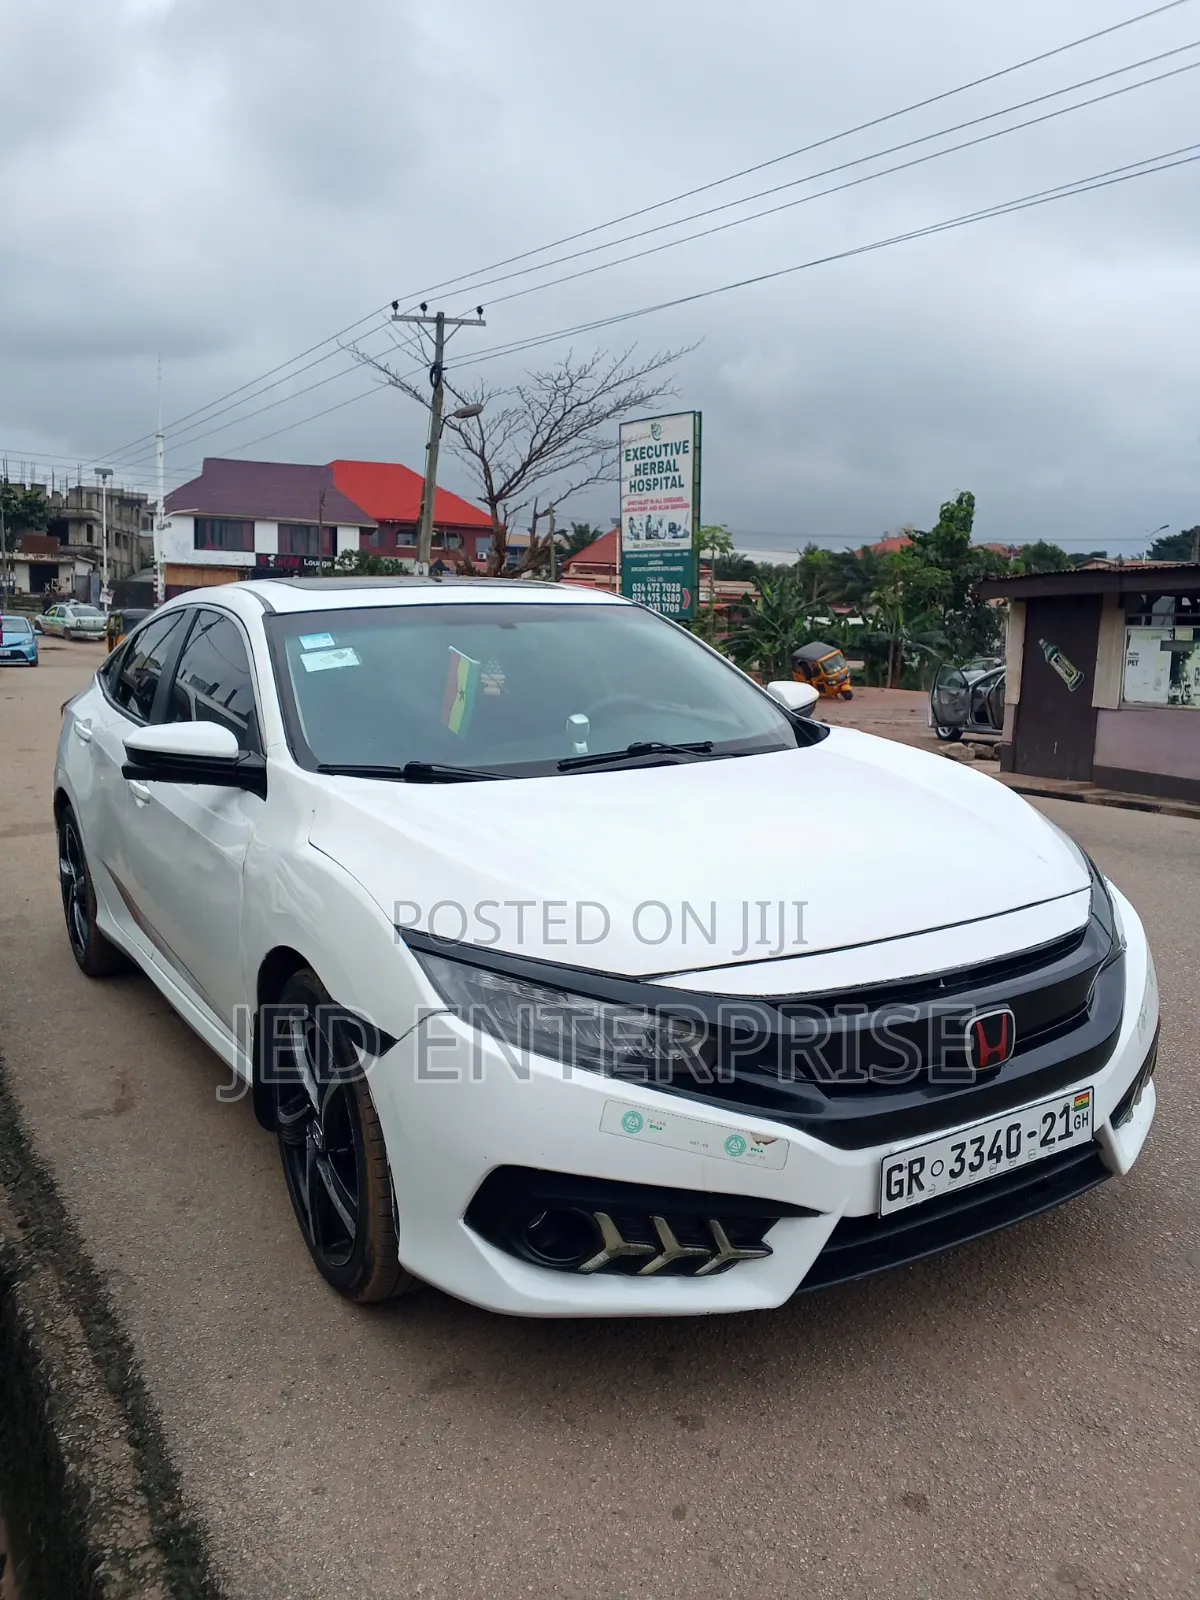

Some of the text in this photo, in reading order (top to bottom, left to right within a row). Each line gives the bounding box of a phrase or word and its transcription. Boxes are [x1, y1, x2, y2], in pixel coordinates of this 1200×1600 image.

[625, 440, 689, 462] EXECUTIVE
[634, 459, 679, 476] HERBAL
[629, 475, 684, 493] HOSPITAL
[632, 583, 681, 592] 024 472 7028
[632, 593, 681, 602] 024 475 4380
[662, 604, 680, 613] 1709
[1073, 1113, 1089, 1131] GH
[886, 1104, 1073, 1202] GR 3340-21
